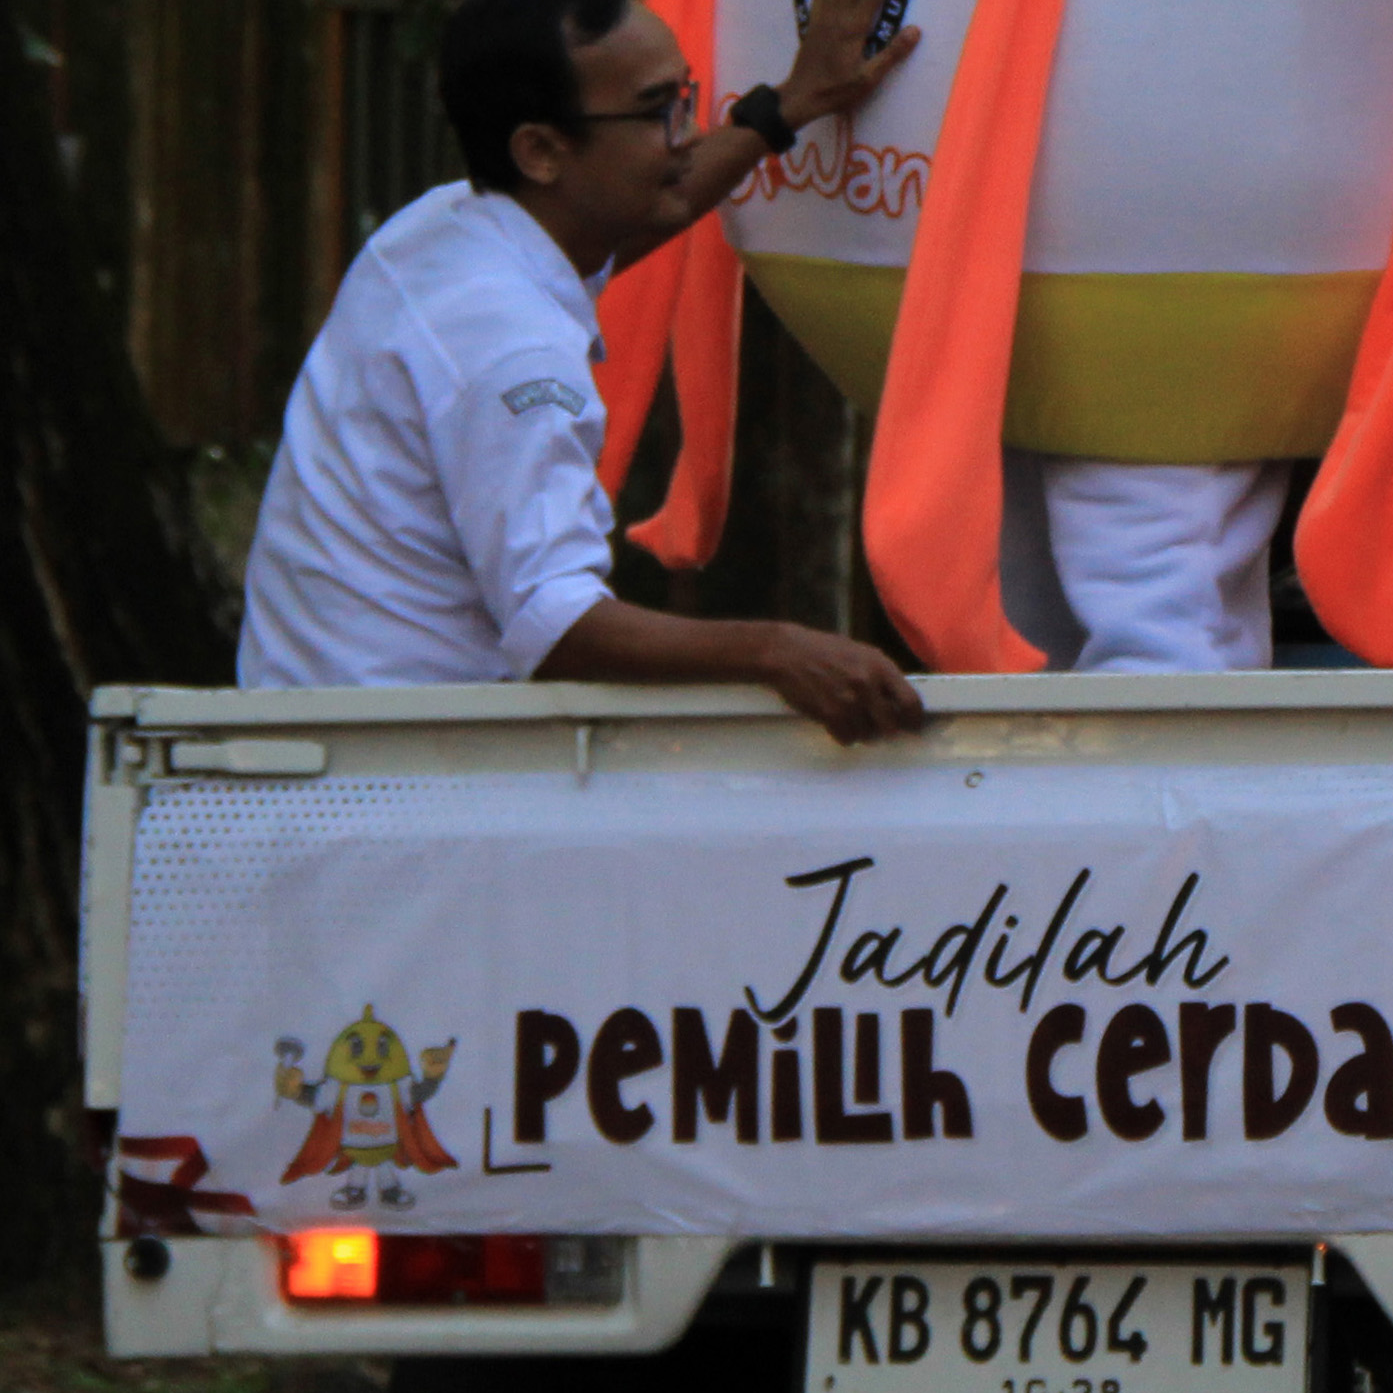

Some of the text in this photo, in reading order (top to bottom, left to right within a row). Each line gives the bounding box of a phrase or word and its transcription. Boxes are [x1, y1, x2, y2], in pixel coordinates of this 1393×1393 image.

[744, 856, 1230, 1022] Jadilah
[838, 1275, 1288, 1366] KB 8764 MG
